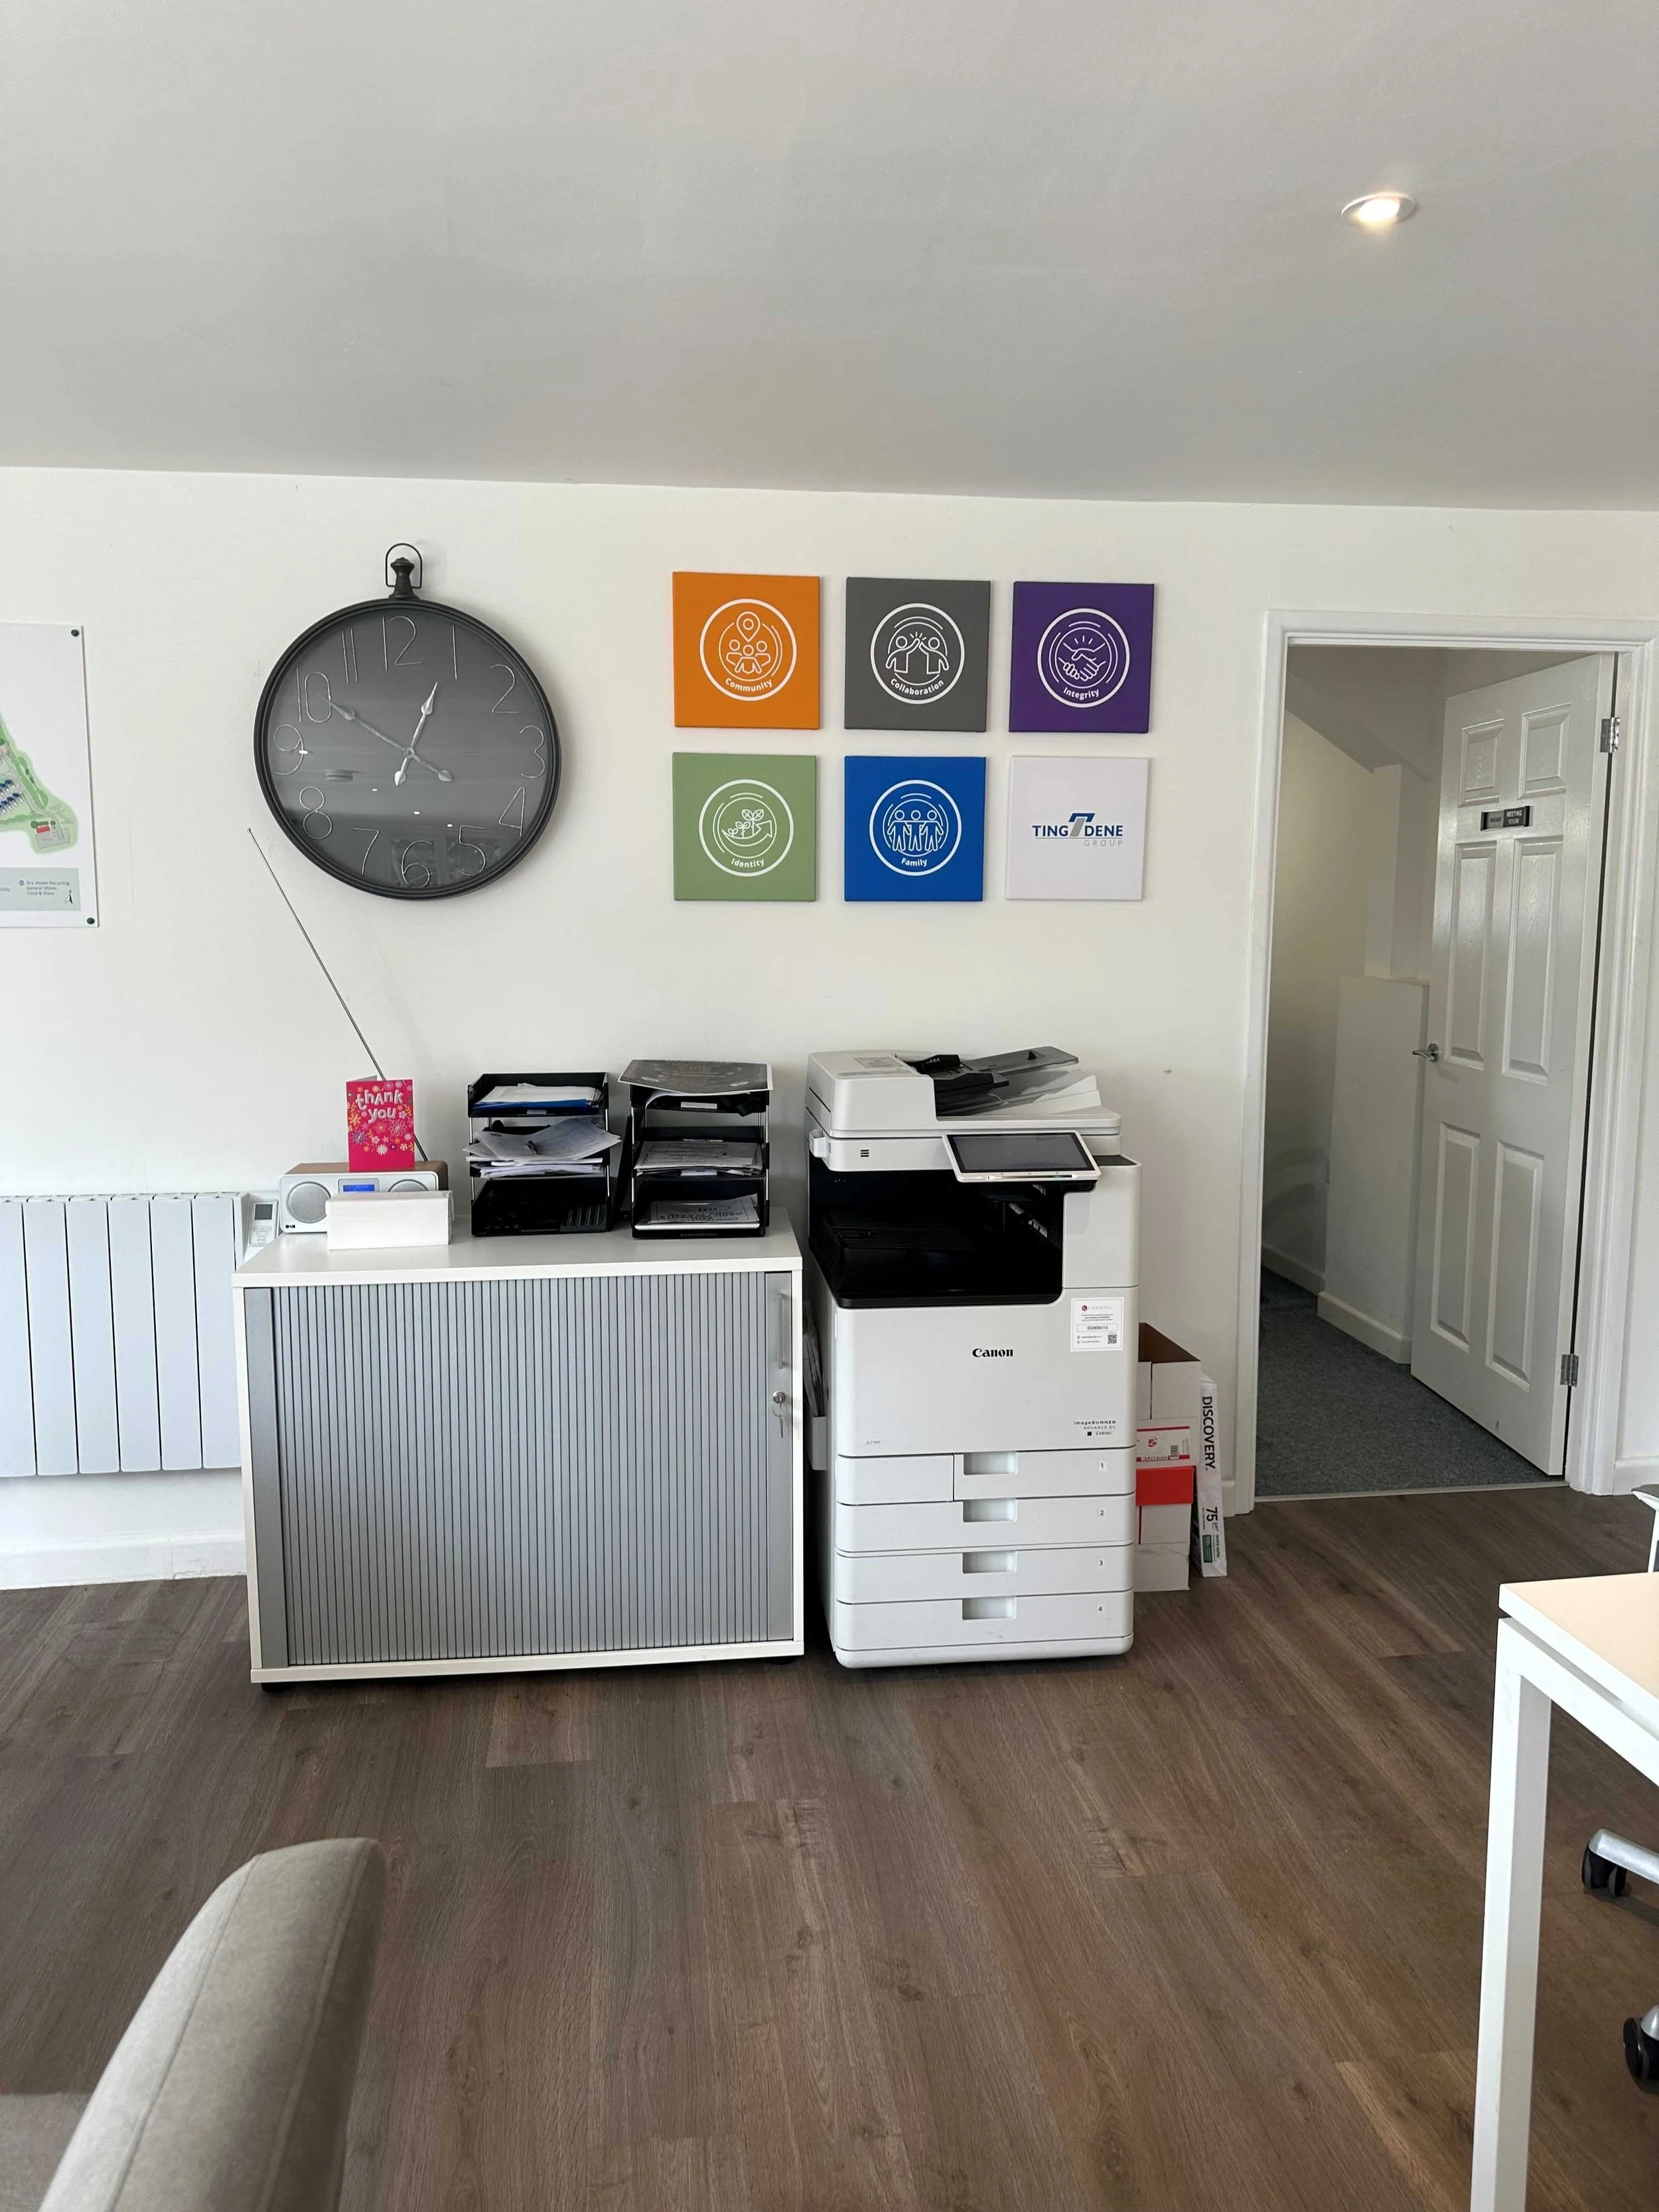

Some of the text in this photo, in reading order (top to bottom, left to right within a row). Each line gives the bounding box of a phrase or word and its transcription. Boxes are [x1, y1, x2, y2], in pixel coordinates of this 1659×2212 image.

[341, 627, 359, 684] 11
[382, 615, 425, 672] 12
[296, 667, 332, 723] 10
[490, 664, 520, 714] 2
[725, 678, 772, 692] Community
[891, 678, 944, 696] Collaboration
[1063, 686, 1099, 701] Integrity
[273, 723, 305, 776] 9
[520, 725, 545, 779] 3
[299, 786, 332, 840] 8
[498, 786, 526, 837] 4
[352, 826, 380, 876] 7
[400, 840, 433, 889] 6
[458, 824, 486, 876] 5
[731, 857, 764, 868] Identity
[901, 857, 928, 867] Family
[972, 1348, 1013, 1358] Canon
[1202, 1396, 1216, 1469] DISCOVERY
[1206, 1507, 1218, 1522] 75
